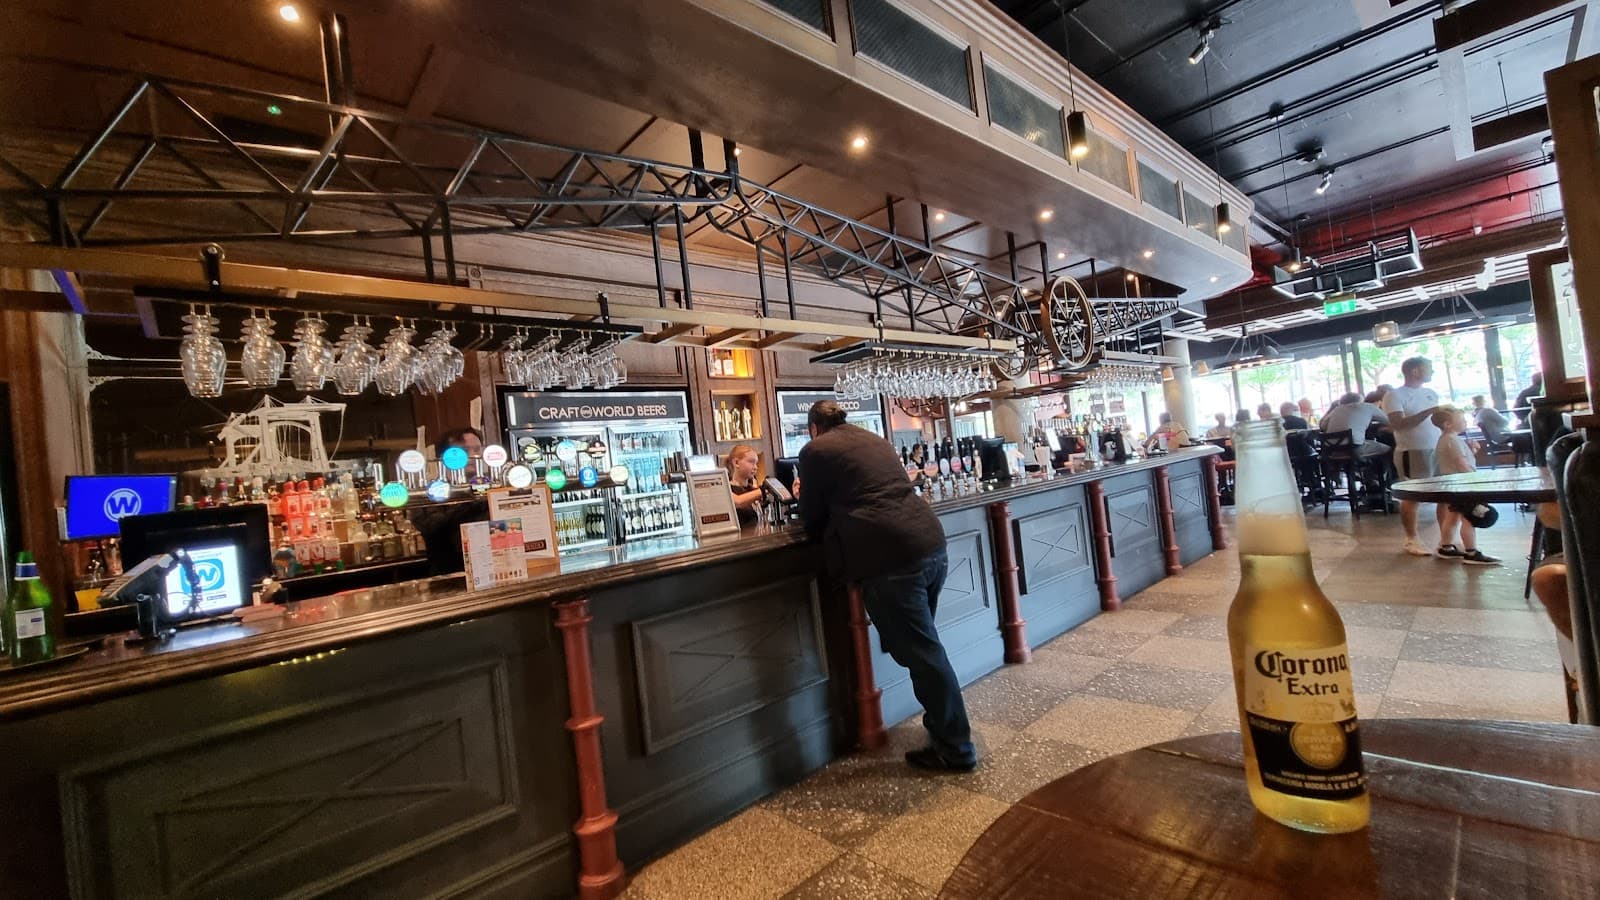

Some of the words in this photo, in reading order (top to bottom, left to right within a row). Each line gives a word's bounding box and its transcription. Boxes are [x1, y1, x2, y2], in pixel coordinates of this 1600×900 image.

[539, 406, 579, 420] CRAFT
[590, 405, 635, 418] WORLD
[637, 404, 668, 416] BEERS
[797, 402, 815, 412] WIN
[1254, 650, 1348, 683] Corona
[1286, 677, 1340, 696] Extra
